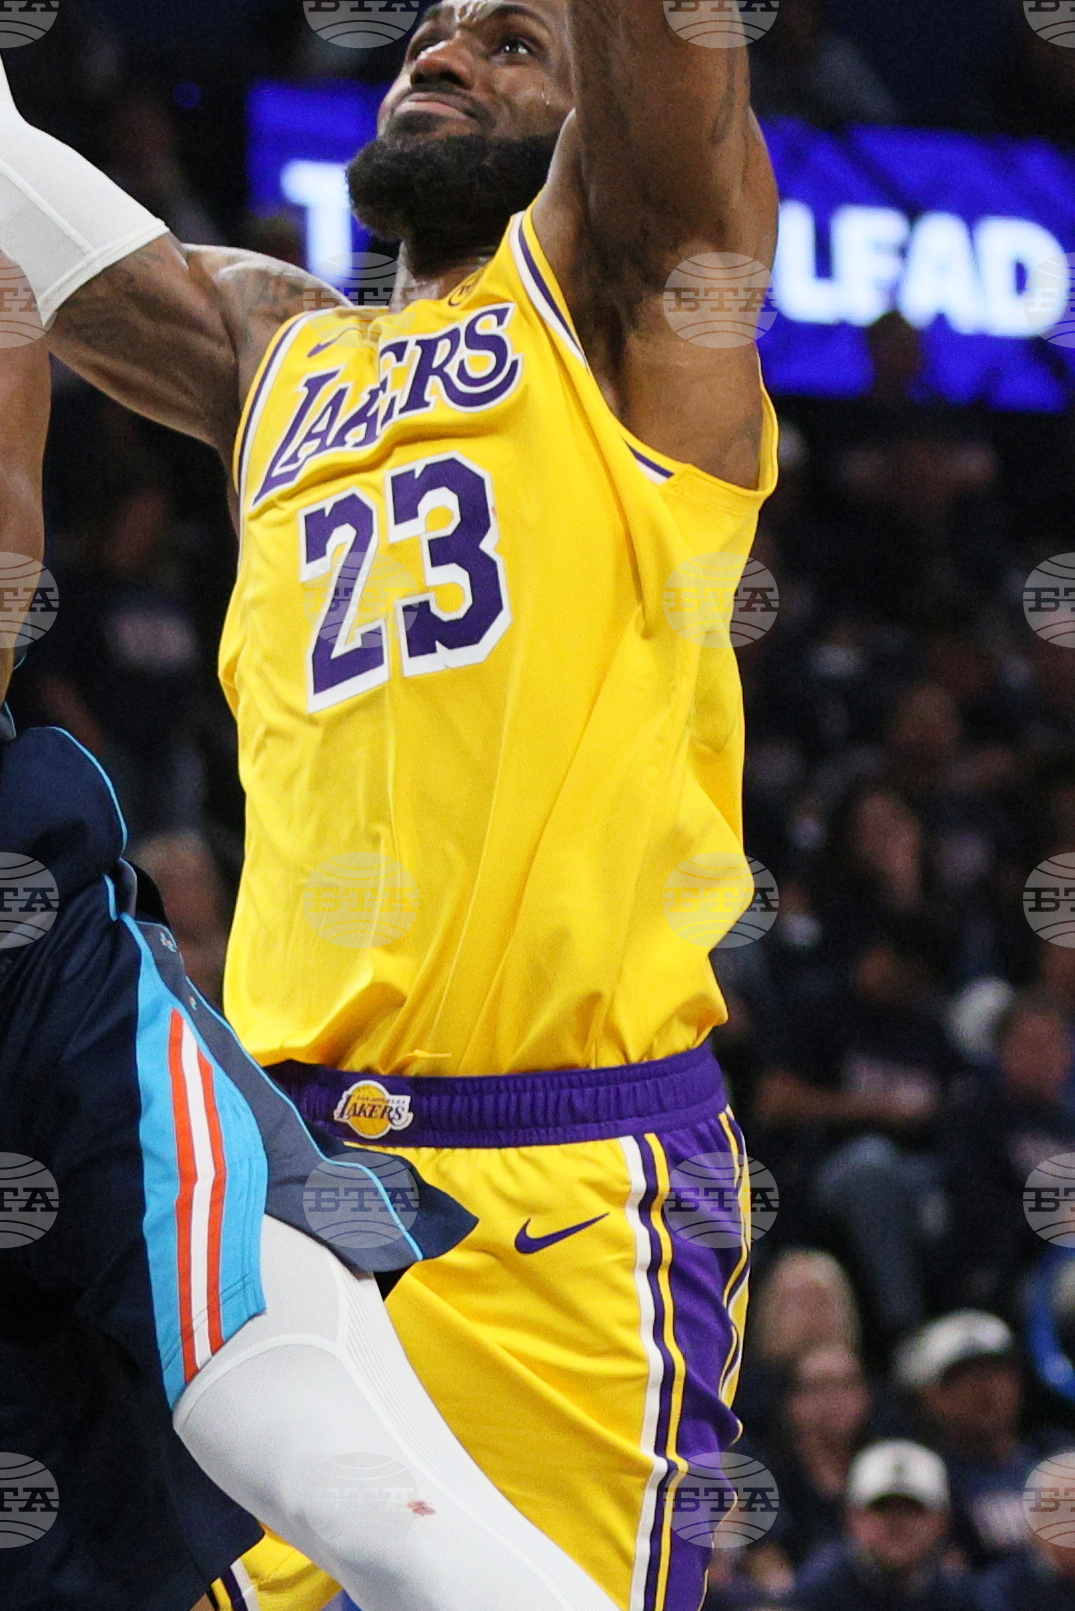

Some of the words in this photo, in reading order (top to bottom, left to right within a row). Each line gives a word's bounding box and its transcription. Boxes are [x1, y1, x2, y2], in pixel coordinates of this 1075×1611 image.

[251, 303, 524, 509] LAKERS
[298, 451, 512, 713] 23
[336, 1094, 410, 1127] LAKERS
